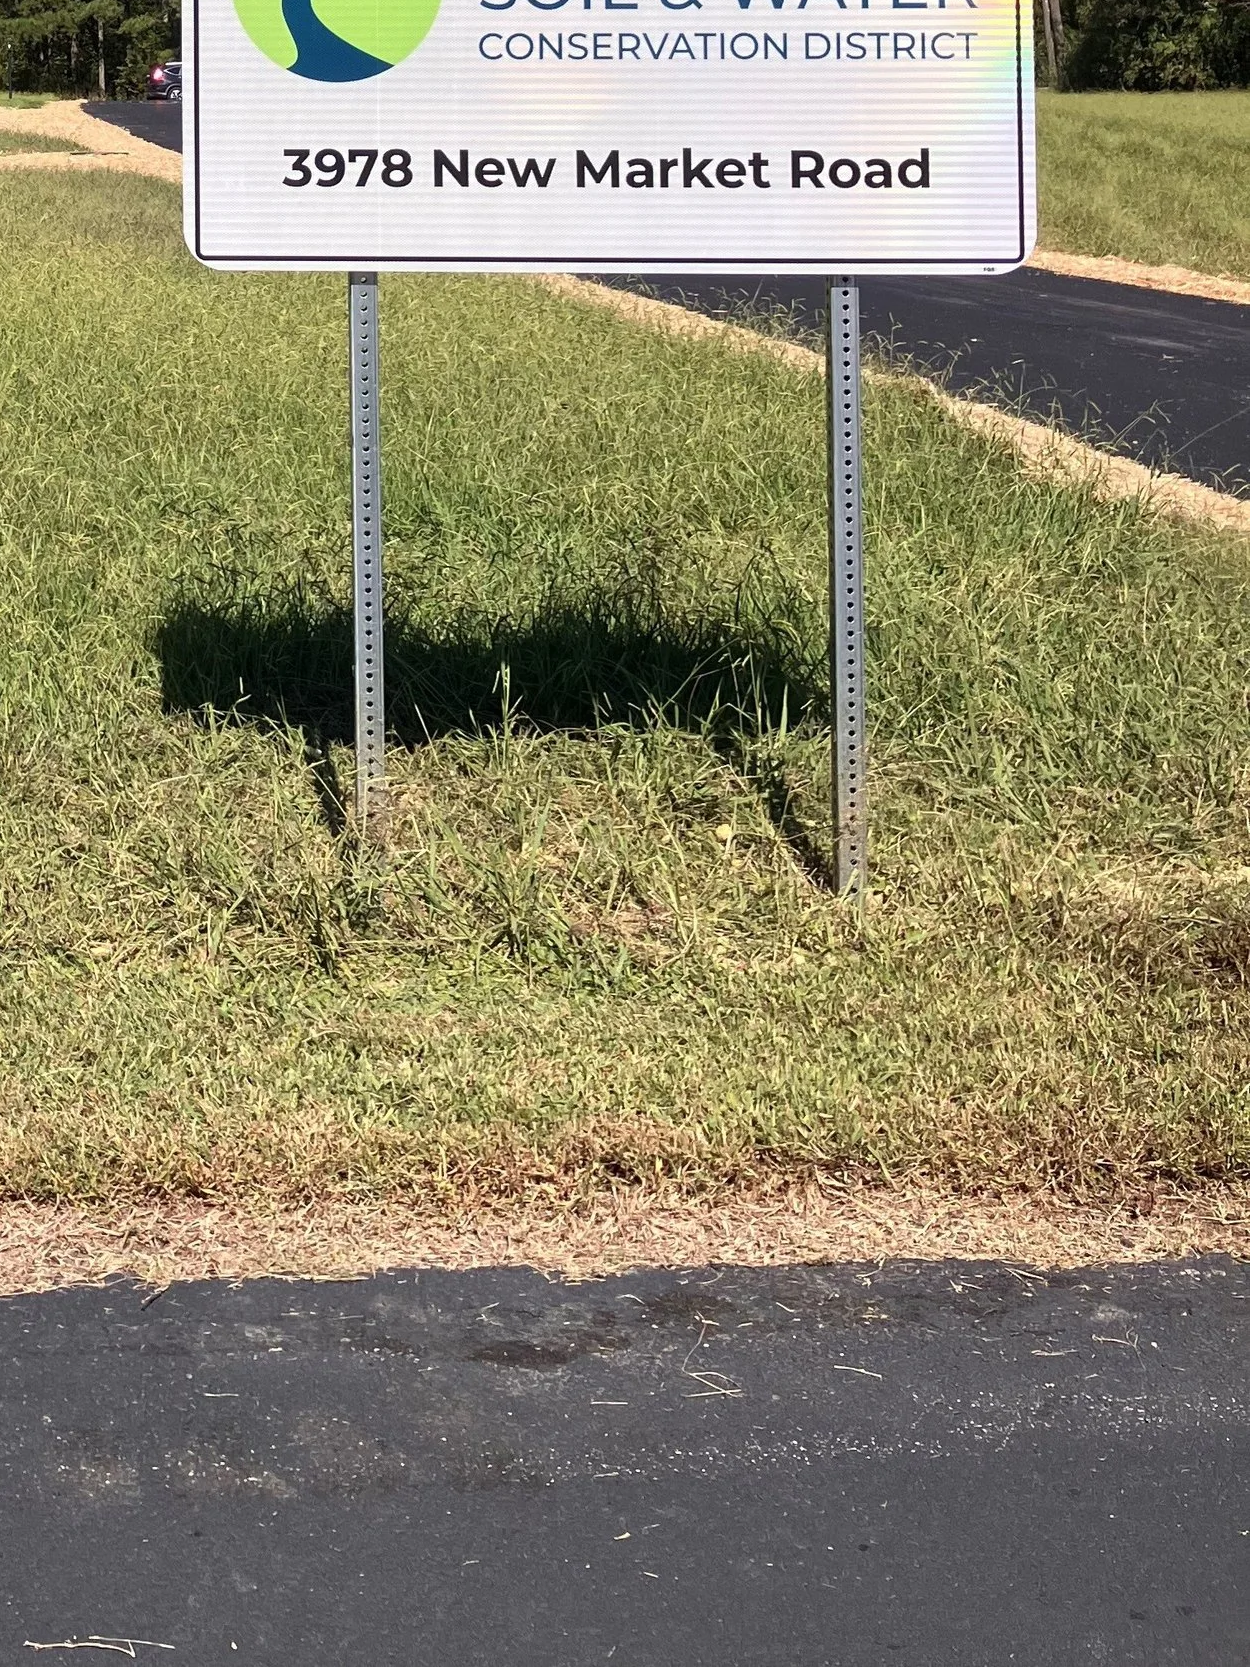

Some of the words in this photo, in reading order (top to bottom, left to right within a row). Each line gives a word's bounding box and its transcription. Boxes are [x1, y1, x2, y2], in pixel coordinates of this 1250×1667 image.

[478, 32, 788, 61] CONSERVATION
[804, 32, 979, 60] DISTRICT
[281, 148, 414, 188] 3978
[433, 149, 557, 188] New
[576, 147, 772, 189] Market
[790, 147, 931, 189] Road
